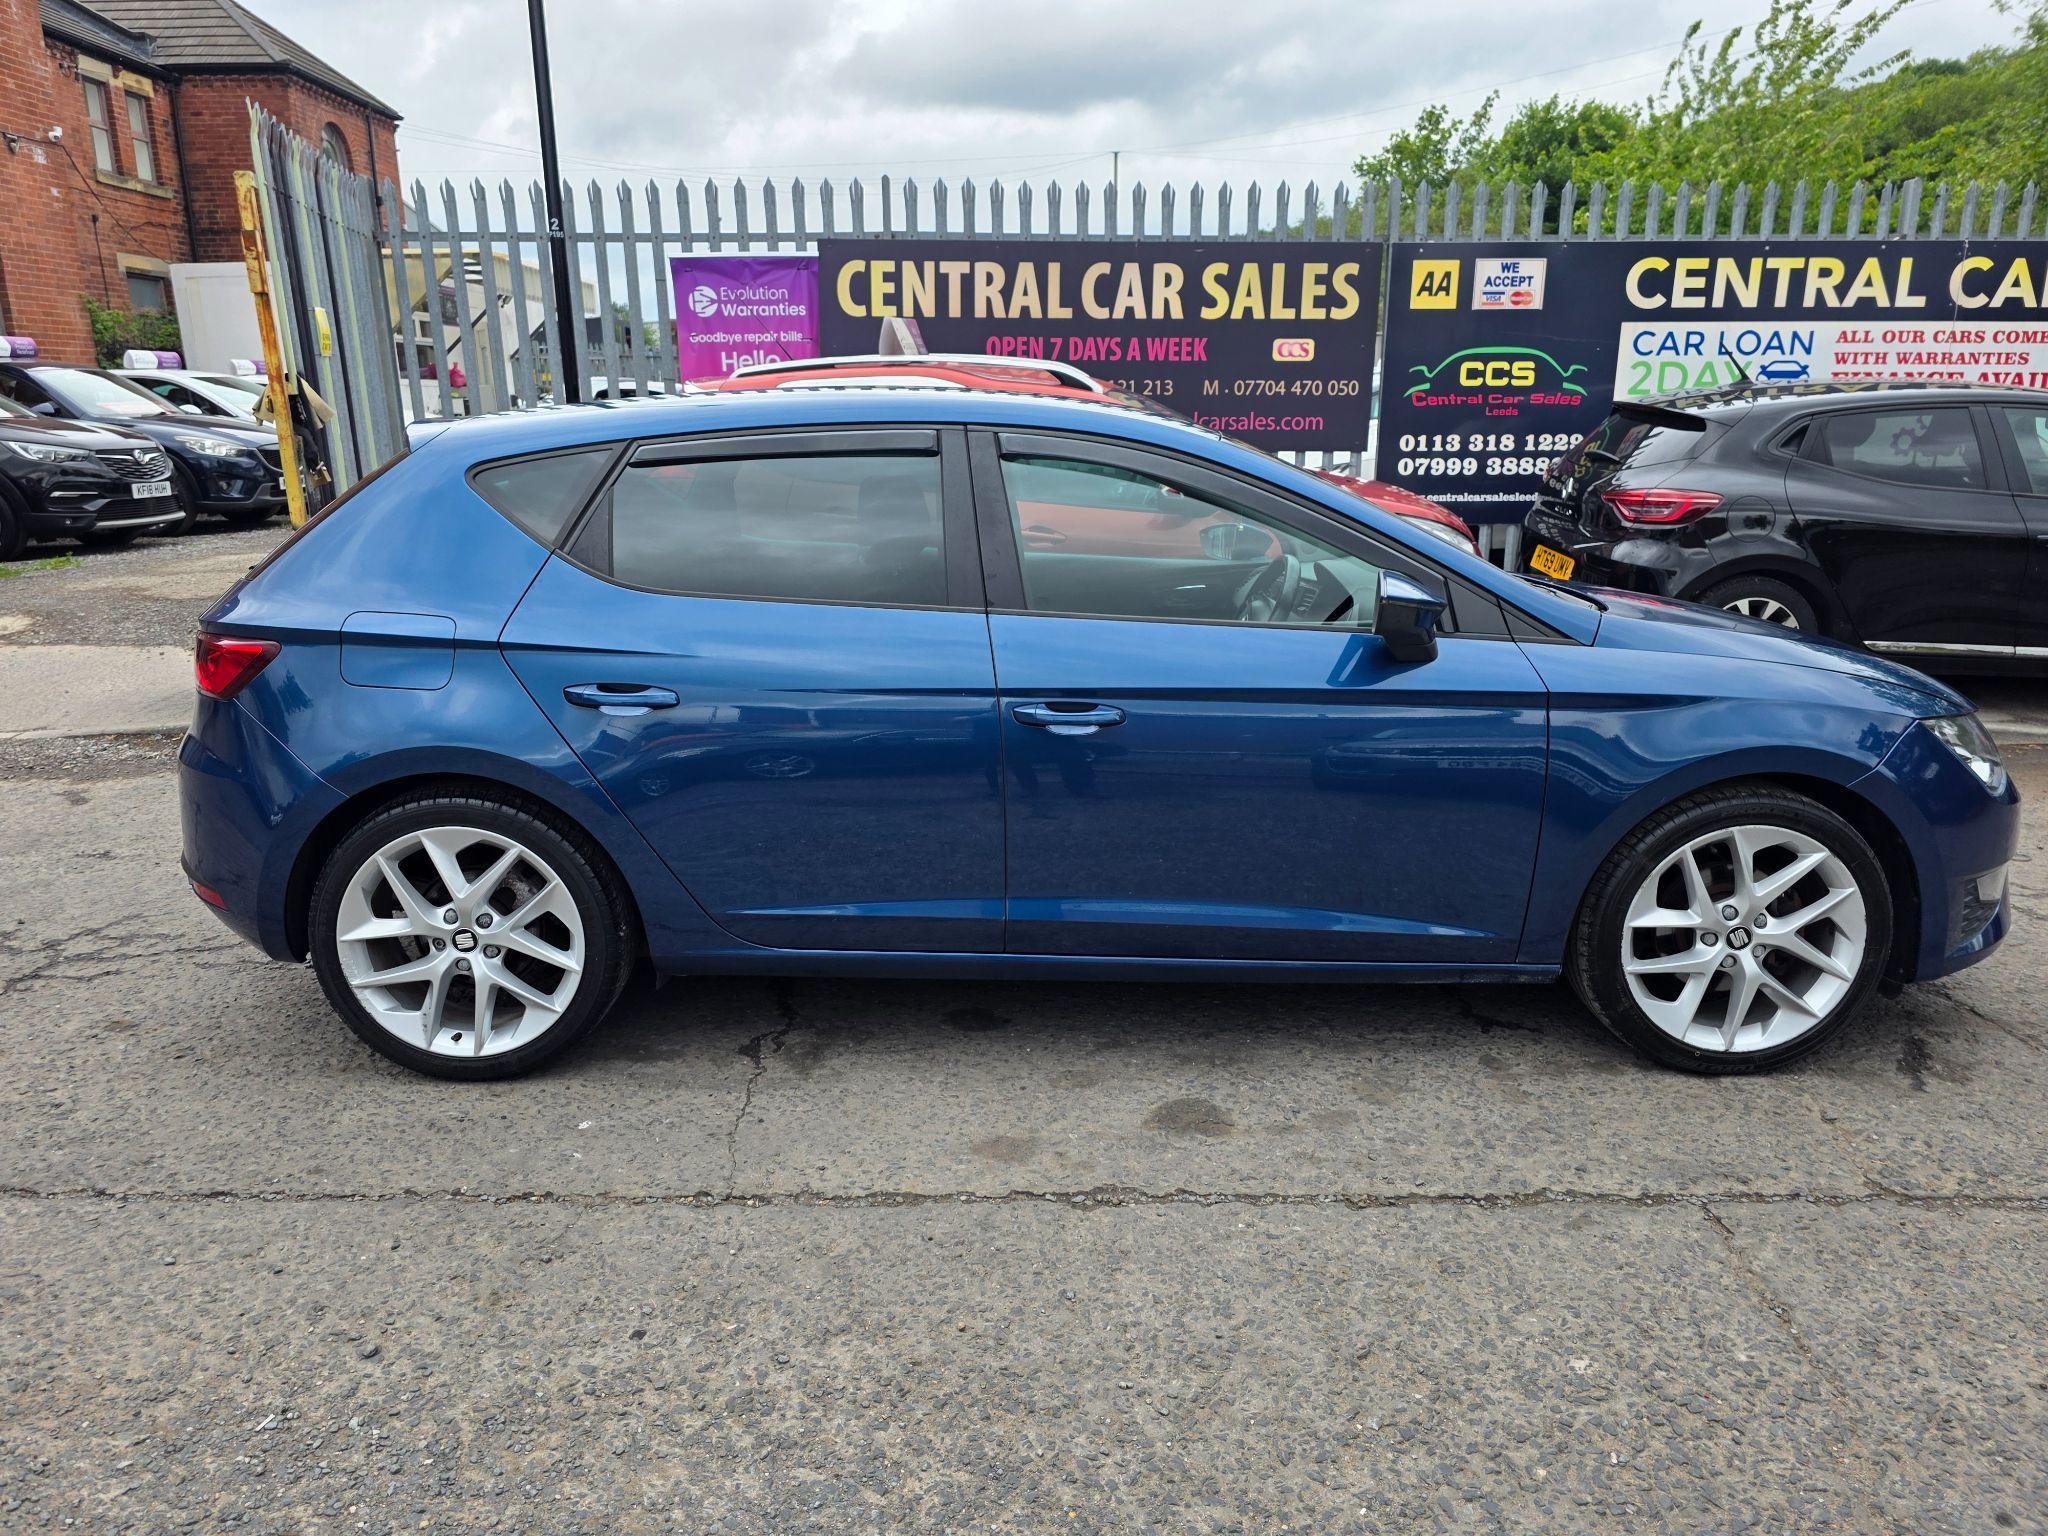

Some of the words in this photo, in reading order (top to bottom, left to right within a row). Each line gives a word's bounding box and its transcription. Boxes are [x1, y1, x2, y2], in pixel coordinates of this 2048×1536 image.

[550, 217, 560, 230] 2
[1500, 261, 1520, 273] WE
[1416, 270, 1452, 297] AA
[1484, 275, 1534, 288] ACCEPT
[1625, 256, 1927, 309] CENTRAL
[1948, 256, 2048, 309] CA
[720, 286, 789, 301] Evolution
[836, 259, 1072, 319] CENTRAL
[1081, 262, 1185, 320] CAR
[1200, 262, 1361, 320] SALES
[721, 303, 807, 317] Warranties
[689, 333, 742, 345] Goodbye
[744, 333, 778, 344] repair
[1632, 330, 1706, 357] CAR
[1717, 330, 1815, 356] LOAN
[1835, 330, 1874, 344] ALL
[1881, 330, 1925, 344] OUR
[1932, 330, 1986, 344] CARS
[986, 336, 1044, 357] OPEN
[1049, 337, 1063, 360] 7
[1068, 337, 1122, 361] DAYS
[1127, 338, 1141, 361] A
[1146, 338, 1208, 362] WEEK
[1834, 352, 1889, 365] WITH
[1896, 352, 2030, 366] WARRANTIES
[1459, 361, 1536, 387] CCS
[1142, 380, 1174, 396] 213
[1203, 380, 1219, 395] M
[1234, 380, 1286, 396] 07704
[1290, 380, 1324, 396] 470
[1327, 380, 1359, 396] 050
[1411, 392, 1482, 407] Central
[1488, 394, 1524, 404] Car
[1529, 393, 1582, 405] Sales
[1485, 407, 1519, 416] Leeds
[1400, 434, 1461, 451] 0113
[1468, 434, 1515, 451] 318
[1398, 457, 1478, 476] 07999
